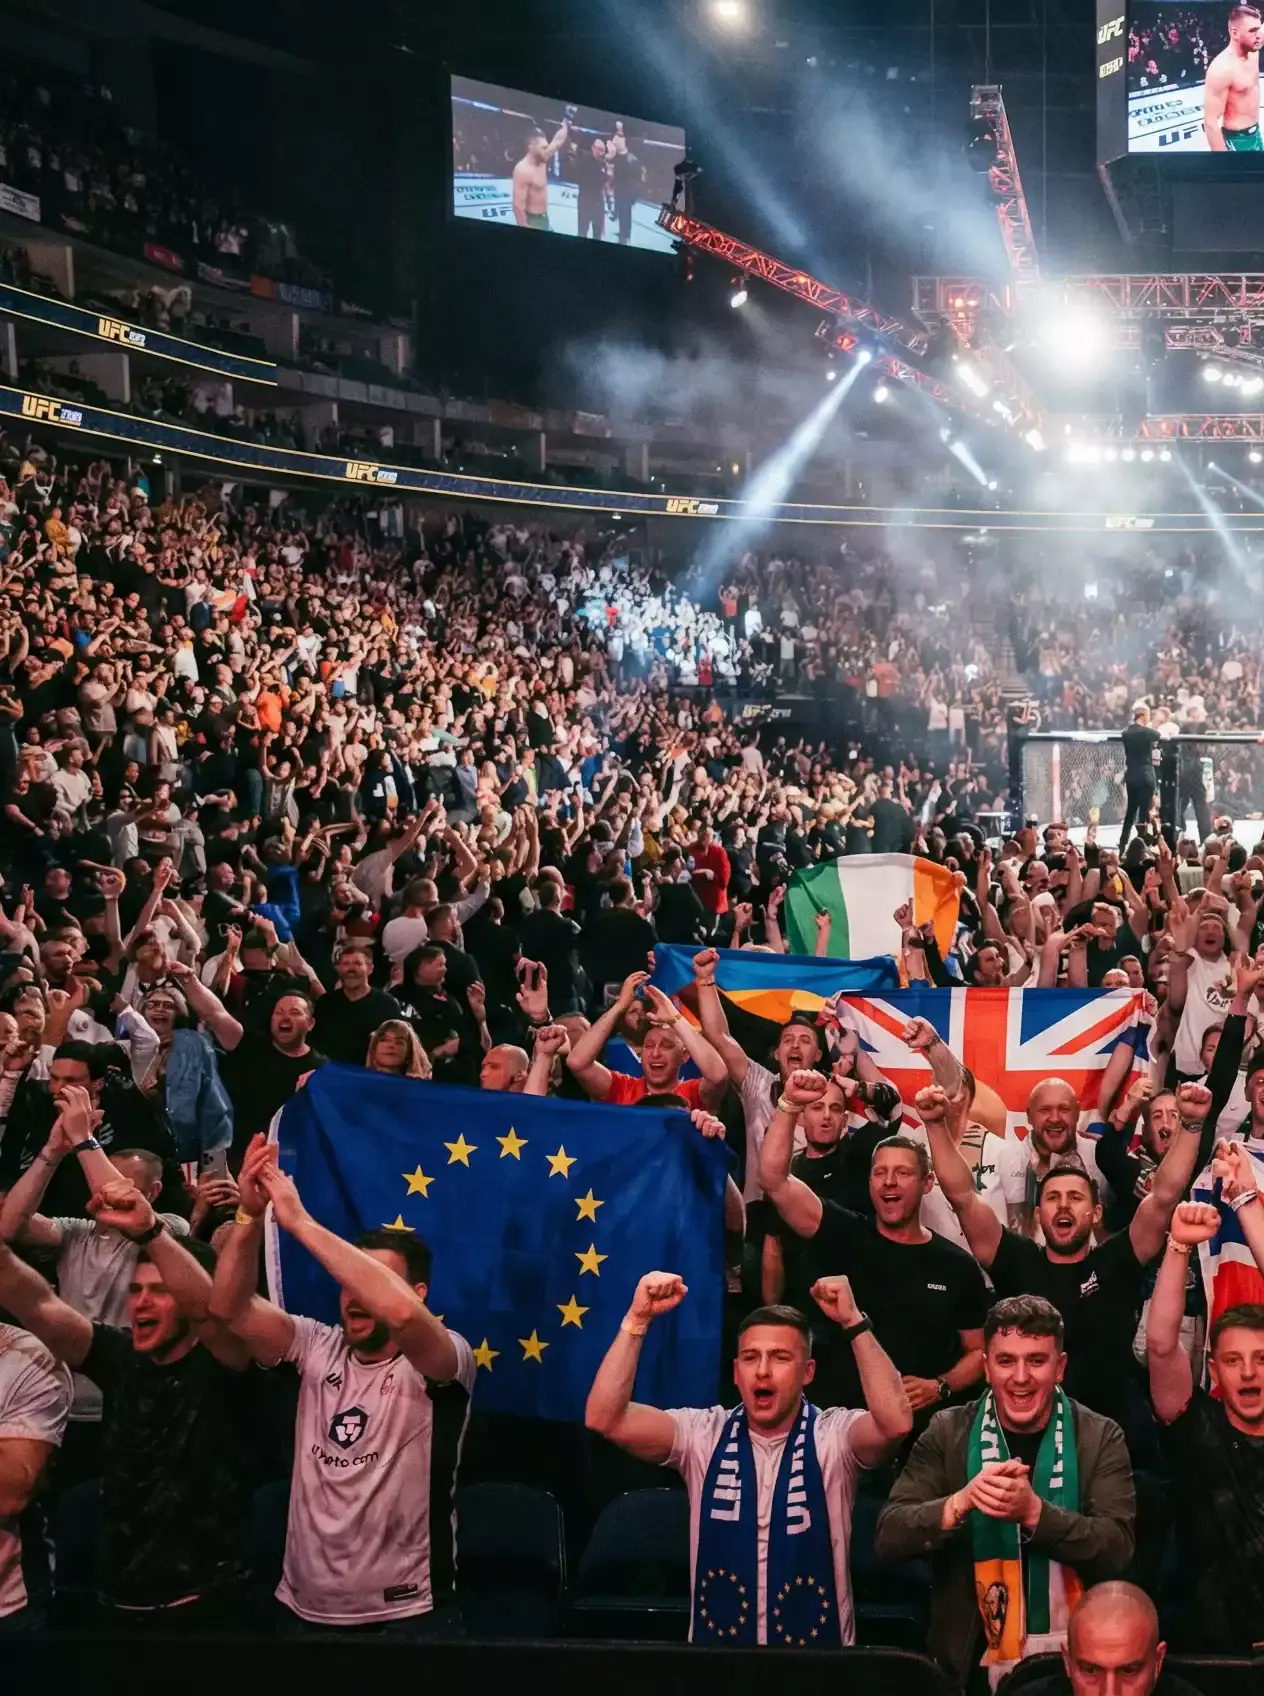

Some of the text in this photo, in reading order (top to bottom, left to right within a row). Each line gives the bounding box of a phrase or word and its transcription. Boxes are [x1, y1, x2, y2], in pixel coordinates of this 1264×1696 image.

[1098, 16, 1125, 44] UFC
[1159, 124, 1206, 146] UF
[99, 318, 130, 342] UFC
[22, 395, 61, 421] UFC
[345, 462, 379, 482] UFC
[666, 499, 699, 513] UFC
